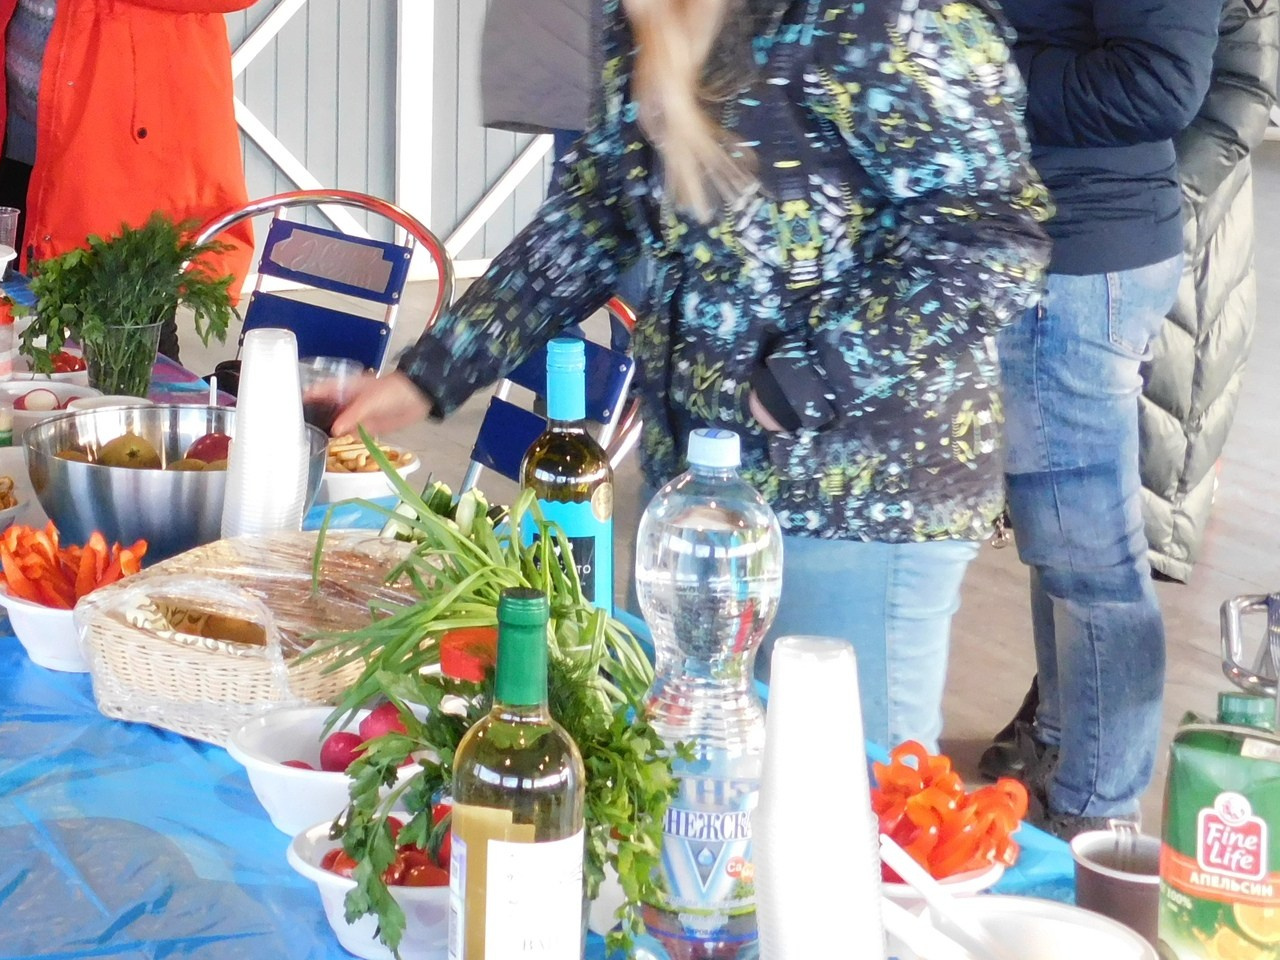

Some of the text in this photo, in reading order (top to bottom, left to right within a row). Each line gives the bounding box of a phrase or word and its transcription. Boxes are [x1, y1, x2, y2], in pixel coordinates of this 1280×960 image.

[662, 806, 752, 840] НЕЖСК
[1206, 822, 1259, 850] Fine
[1209, 840, 1255, 872] Life
[1189, 871, 1274, 897] АПЕЛЬСИН
